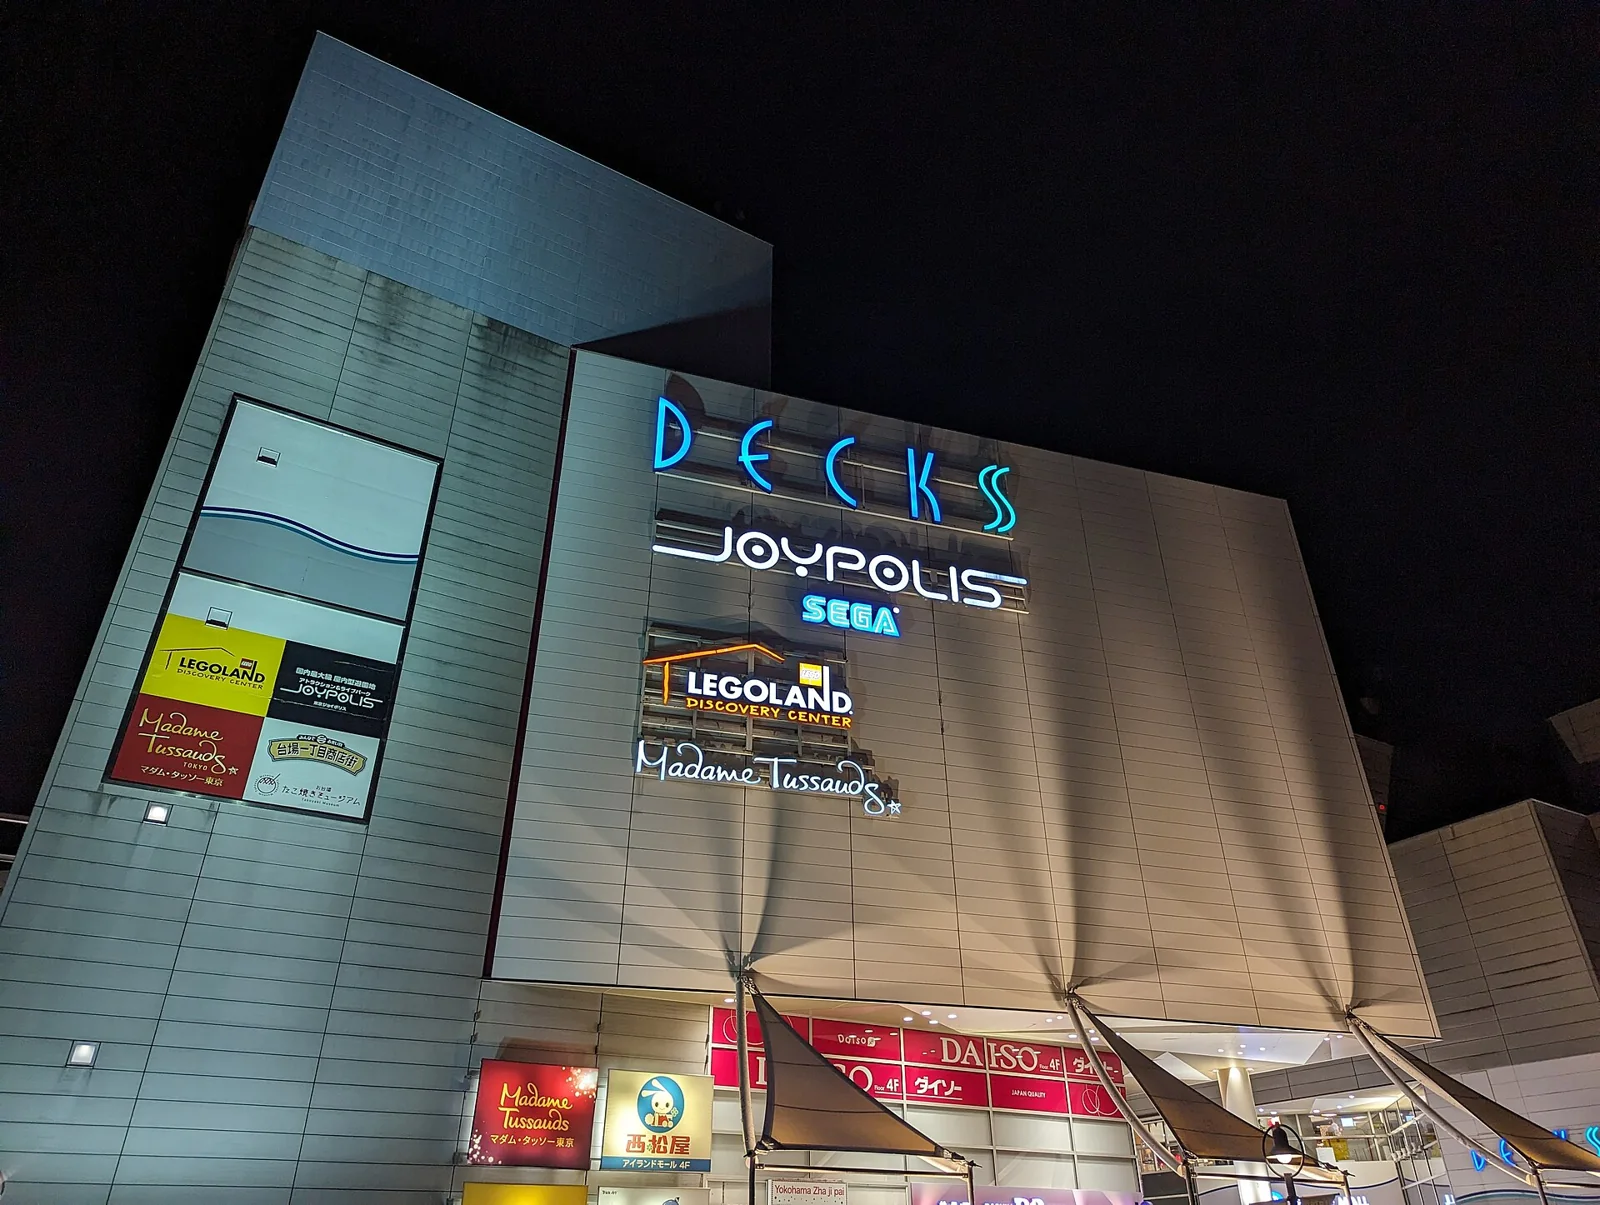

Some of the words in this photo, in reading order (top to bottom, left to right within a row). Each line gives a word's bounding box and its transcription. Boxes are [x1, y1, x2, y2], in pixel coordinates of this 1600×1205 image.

[653, 396, 1016, 533] DECKS
[652, 526, 1028, 608] JOYPOLIS
[802, 594, 900, 637] SEGA
[177, 668, 226, 682] DISCOVERY
[229, 679, 263, 690] CENTER
[179, 657, 265, 683] LEGOLAND
[280, 683, 383, 709] JOYPOLIS
[687, 666, 852, 714] LEGOLAND
[139, 708, 224, 741] Madame
[687, 697, 780, 719] DISCOVERY
[788, 710, 852, 728] CENTER
[138, 733, 227, 774] Tussauds
[183, 761, 208, 771] TOKYO
[277, 742, 359, 768] 台場一丁目商店街
[141, 765, 224, 787] マダム・タッソー東京
[636, 740, 762, 784] Madame
[753, 757, 885, 815] Tussauds
[940, 1037, 1039, 1072] DAISO
[1049, 1058, 1061, 1071] 4F
[1073, 1056, 1113, 1074] ダイー
[500, 1082, 573, 1109] Madame
[886, 1079, 899, 1092] 4F
[914, 1076, 962, 1094] ダイソー
[1012, 1089, 1027, 1097] JAPAN
[498, 1107, 570, 1131] Tussauds
[490, 1134, 575, 1148] マダム・タッソー東京
[625, 1134, 690, 1155] 西松屋
[622, 1159, 677, 1168] アイランドモール
[679, 1161, 691, 1169] 4F
[774, 1185, 811, 1195] Yokohama
[813, 1186, 826, 1195] Zha
[827, 1187, 832, 1197] ji
[834, 1187, 845, 1197] pai
